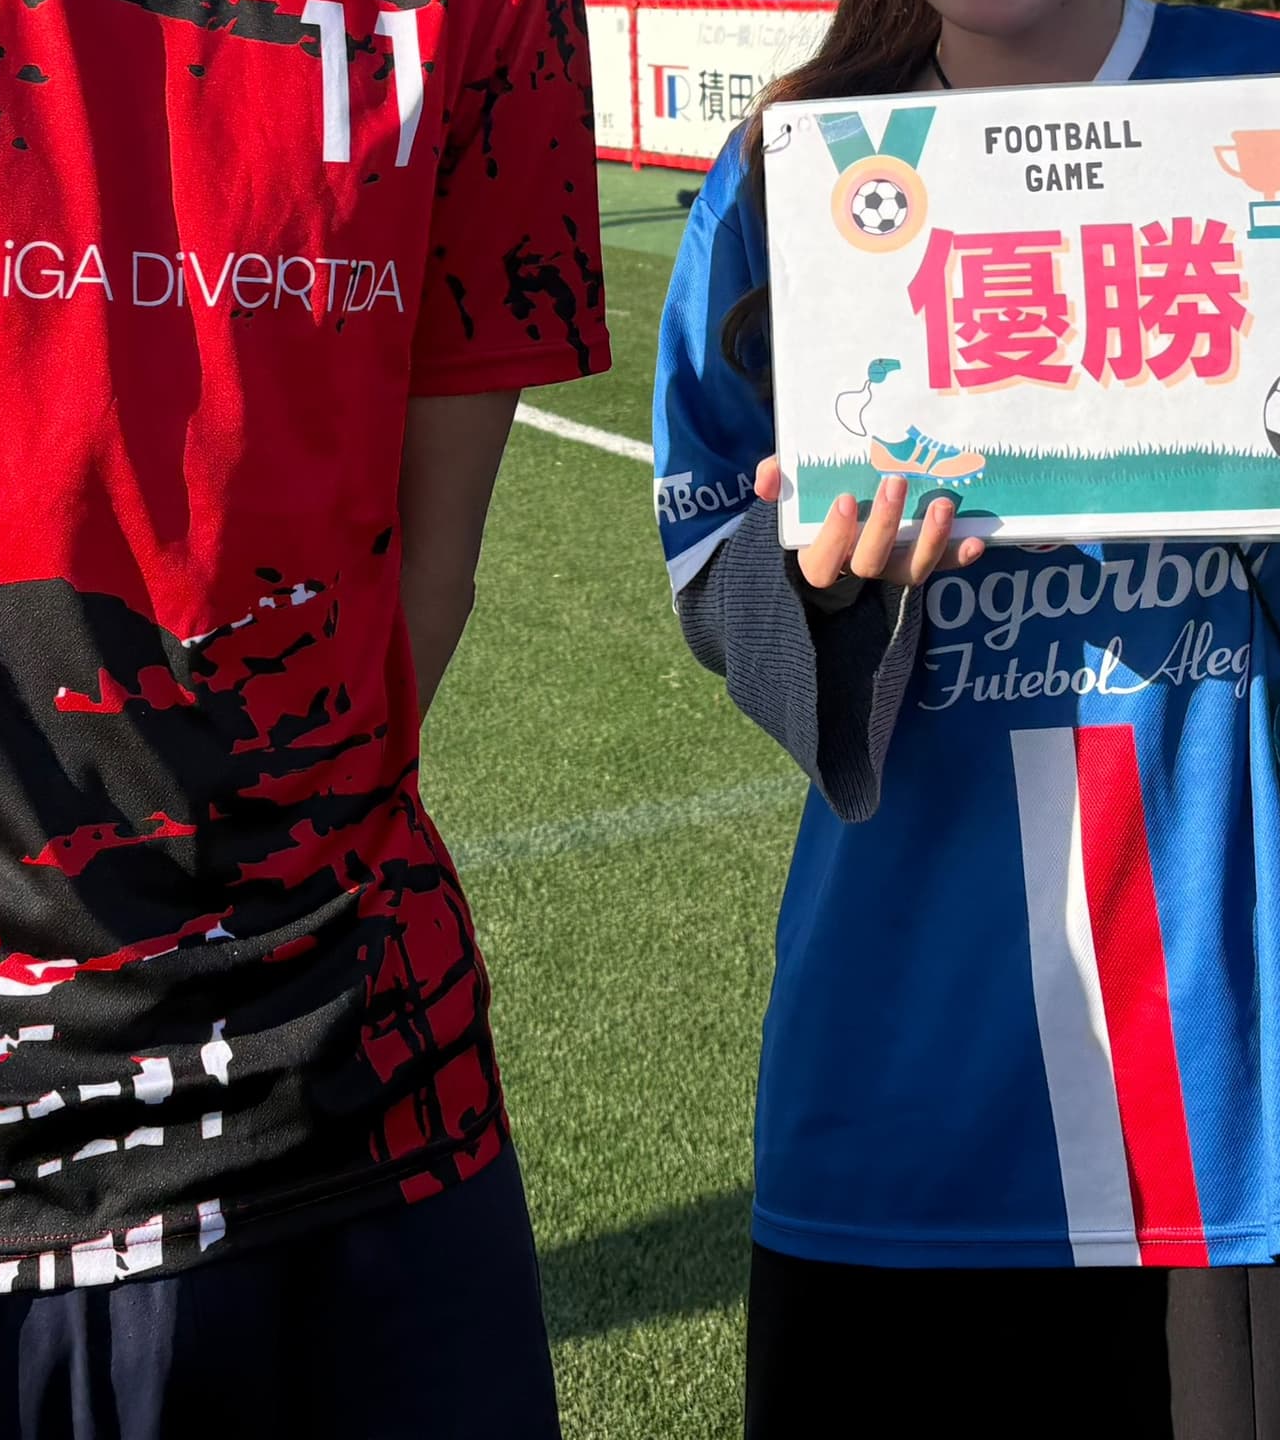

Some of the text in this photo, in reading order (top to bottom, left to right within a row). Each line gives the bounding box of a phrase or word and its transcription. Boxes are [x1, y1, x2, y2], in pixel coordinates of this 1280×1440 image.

[698, 69, 776, 122] 積田
[984, 120, 1143, 154] FOOTBALL
[1025, 161, 1105, 192] GAME
[907, 216, 1253, 396] 優勝
[918, 636, 1148, 711] Futebol
